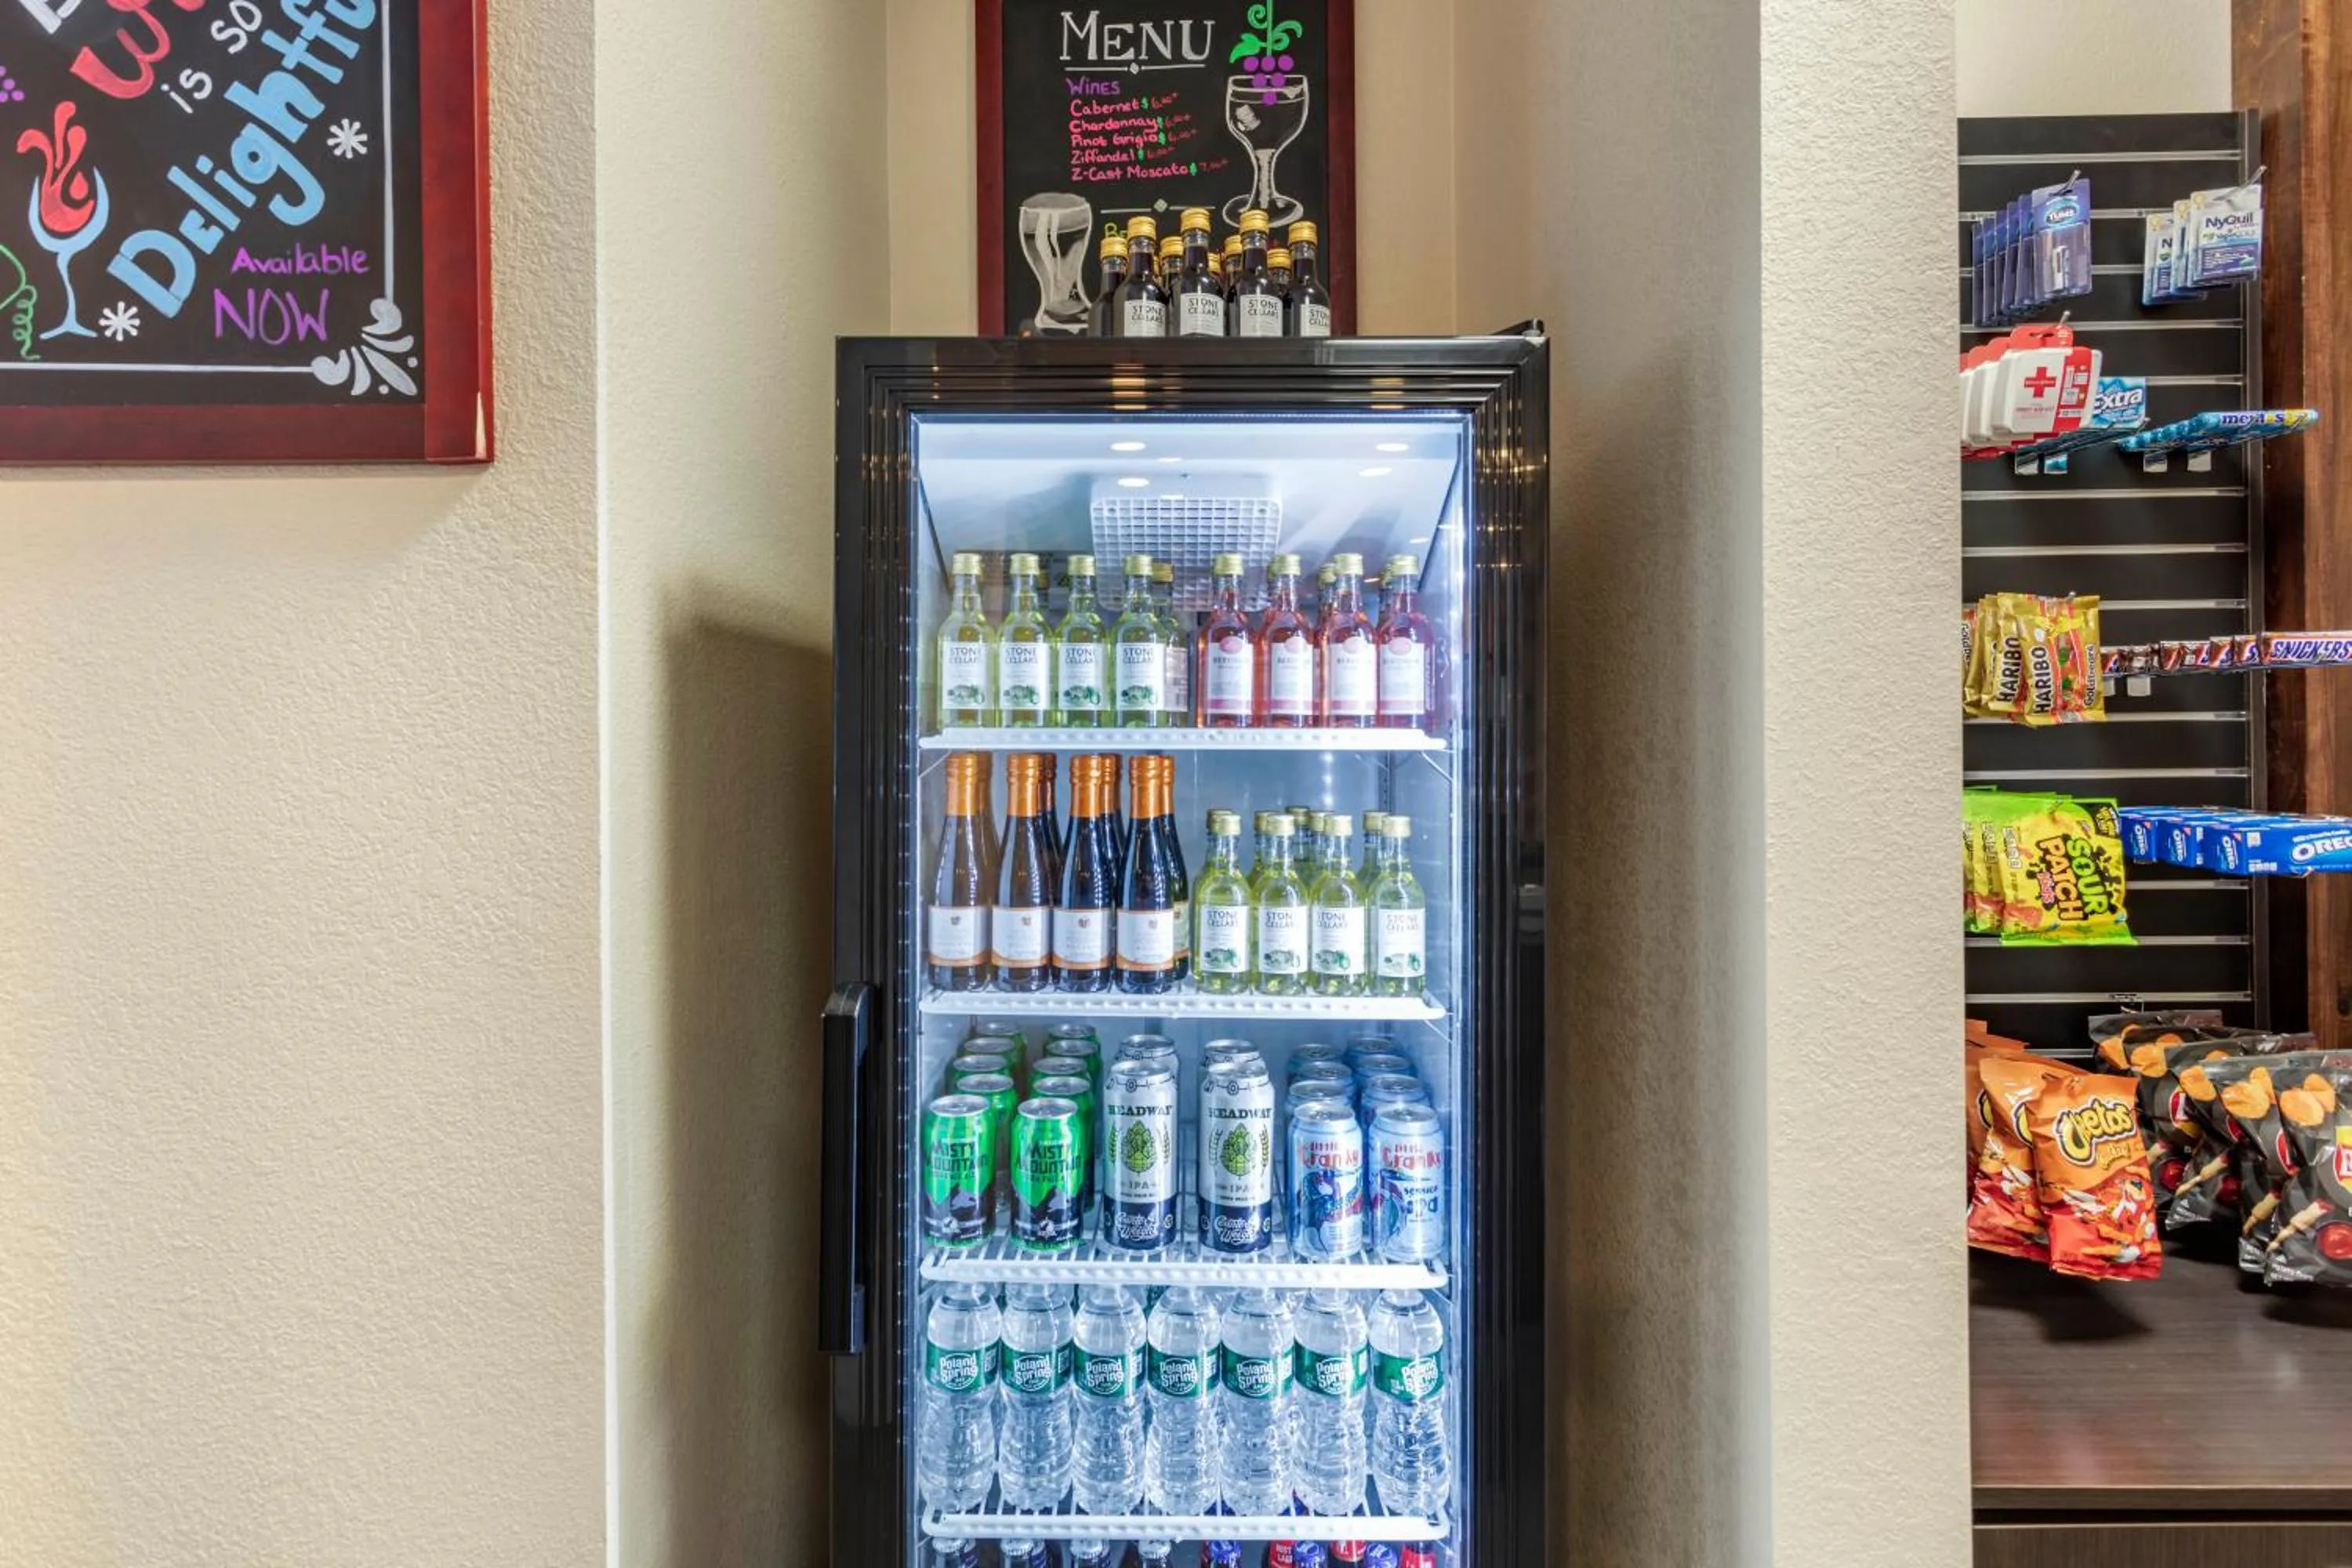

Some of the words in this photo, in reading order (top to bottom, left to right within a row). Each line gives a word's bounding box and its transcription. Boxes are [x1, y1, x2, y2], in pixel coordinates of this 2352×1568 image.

[1059, 10, 1216, 60] MENU
[161, 68, 213, 114] is
[1070, 98, 1139, 117] Cabernet
[1069, 117, 1158, 133] Chardonnay
[1126, 162, 1189, 179] Moscato
[2205, 212, 2253, 230] NyQuil
[231, 242, 370, 274] Available
[213, 288, 329, 346] NOW
[2093, 389, 2143, 414] Extra
[1996, 637, 2022, 702] HARIBO
[2031, 646, 2053, 714] HARIBO
[2222, 836, 2234, 869] OREO
[2038, 836, 2084, 920] PATCH
[2066, 837, 2108, 915] SOUR
[1108, 1105, 1173, 1117] HEADWAY
[1208, 1106, 1272, 1119] HEADWAY
[940, 1352, 976, 1370] Poland
[1014, 1355, 1050, 1372] Poland
[1087, 1359, 1121, 1374] Poland
[1160, 1359, 1195, 1374] Poland
[1237, 1359, 1274, 1374] Poland
[941, 1366, 978, 1383] Spring
[1014, 1368, 1051, 1385] Spring
[1087, 1371, 1123, 1387] Spring
[1161, 1371, 1198, 1387] Spring
